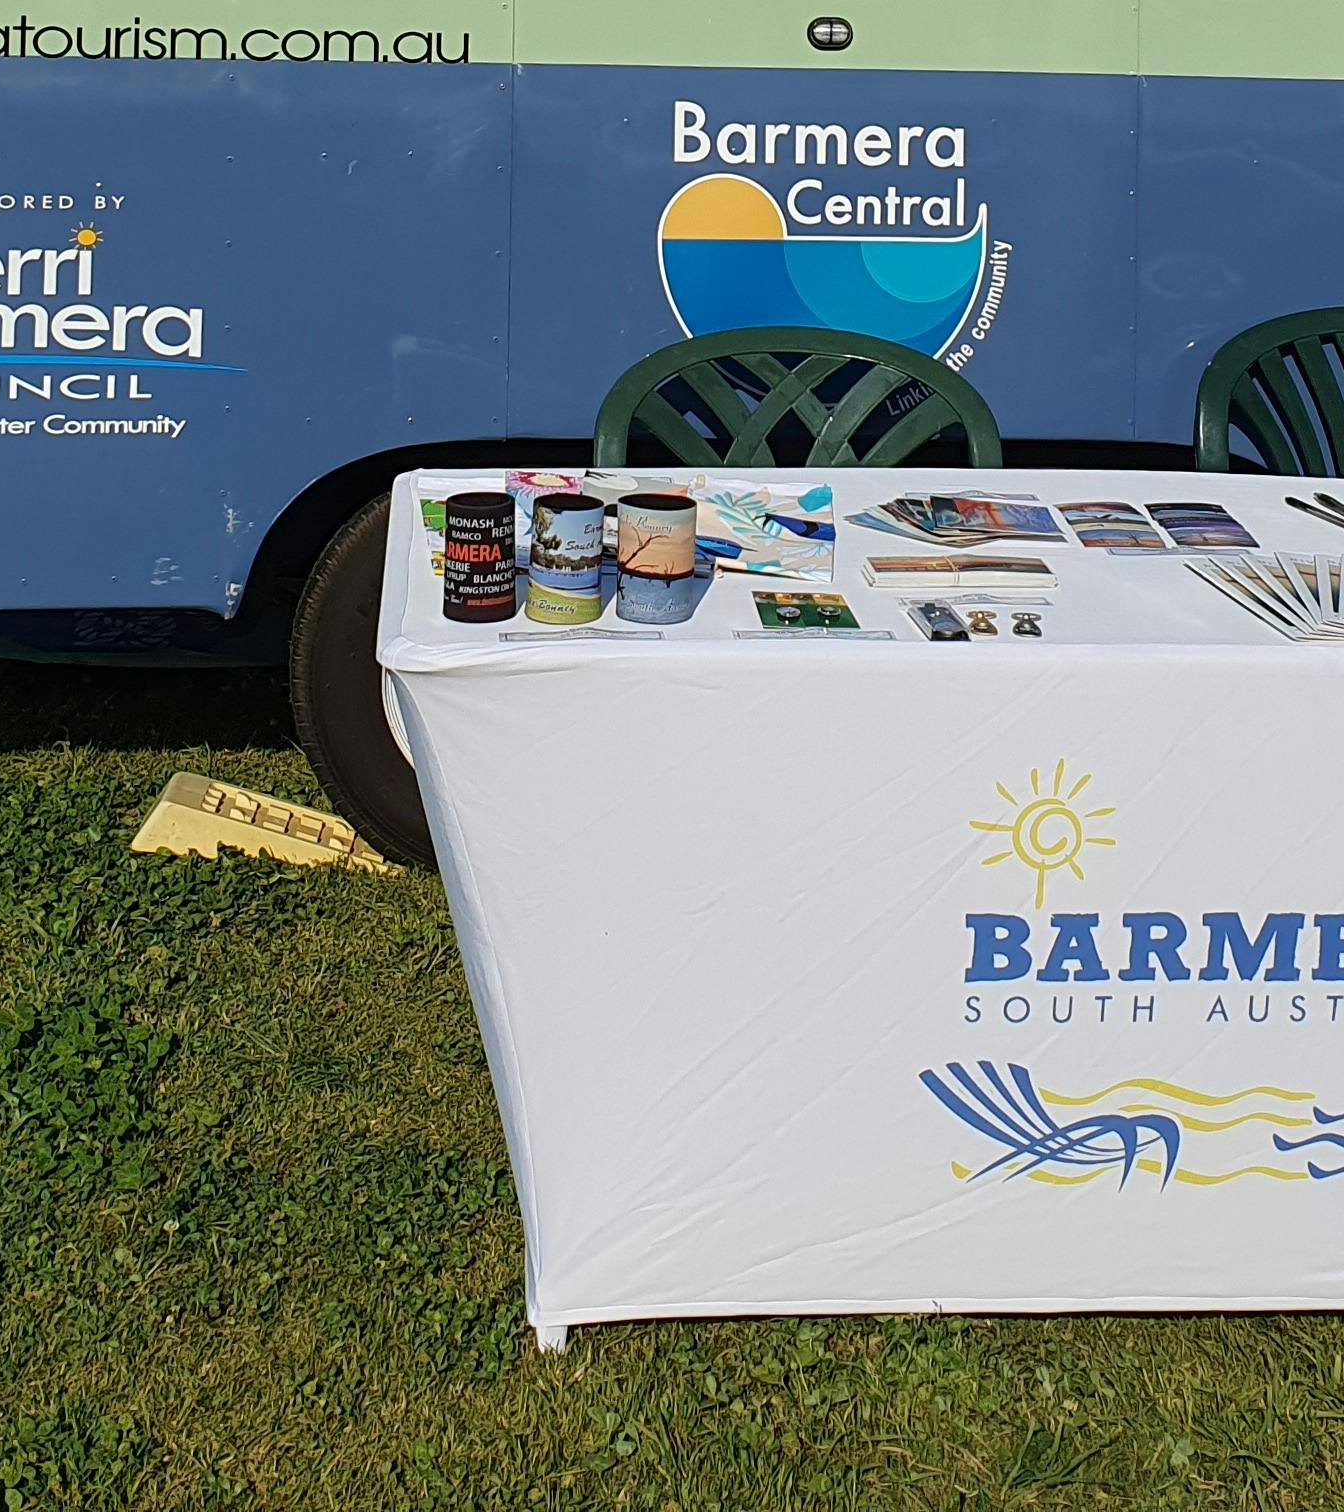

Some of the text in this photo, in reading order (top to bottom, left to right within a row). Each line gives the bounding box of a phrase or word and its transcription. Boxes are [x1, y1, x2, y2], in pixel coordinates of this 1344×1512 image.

[673, 100, 966, 168] Barmera
[94, 195, 126, 211] BY
[786, 178, 965, 227] Central
[885, 240, 1013, 417] Linki the community
[43, 414, 187, 439] Community
[449, 515, 494, 528] MONASH
[446, 541, 502, 562] RMERA
[458, 585, 500, 594] KINGSTON
[964, 994, 1156, 1023] SOUTH
